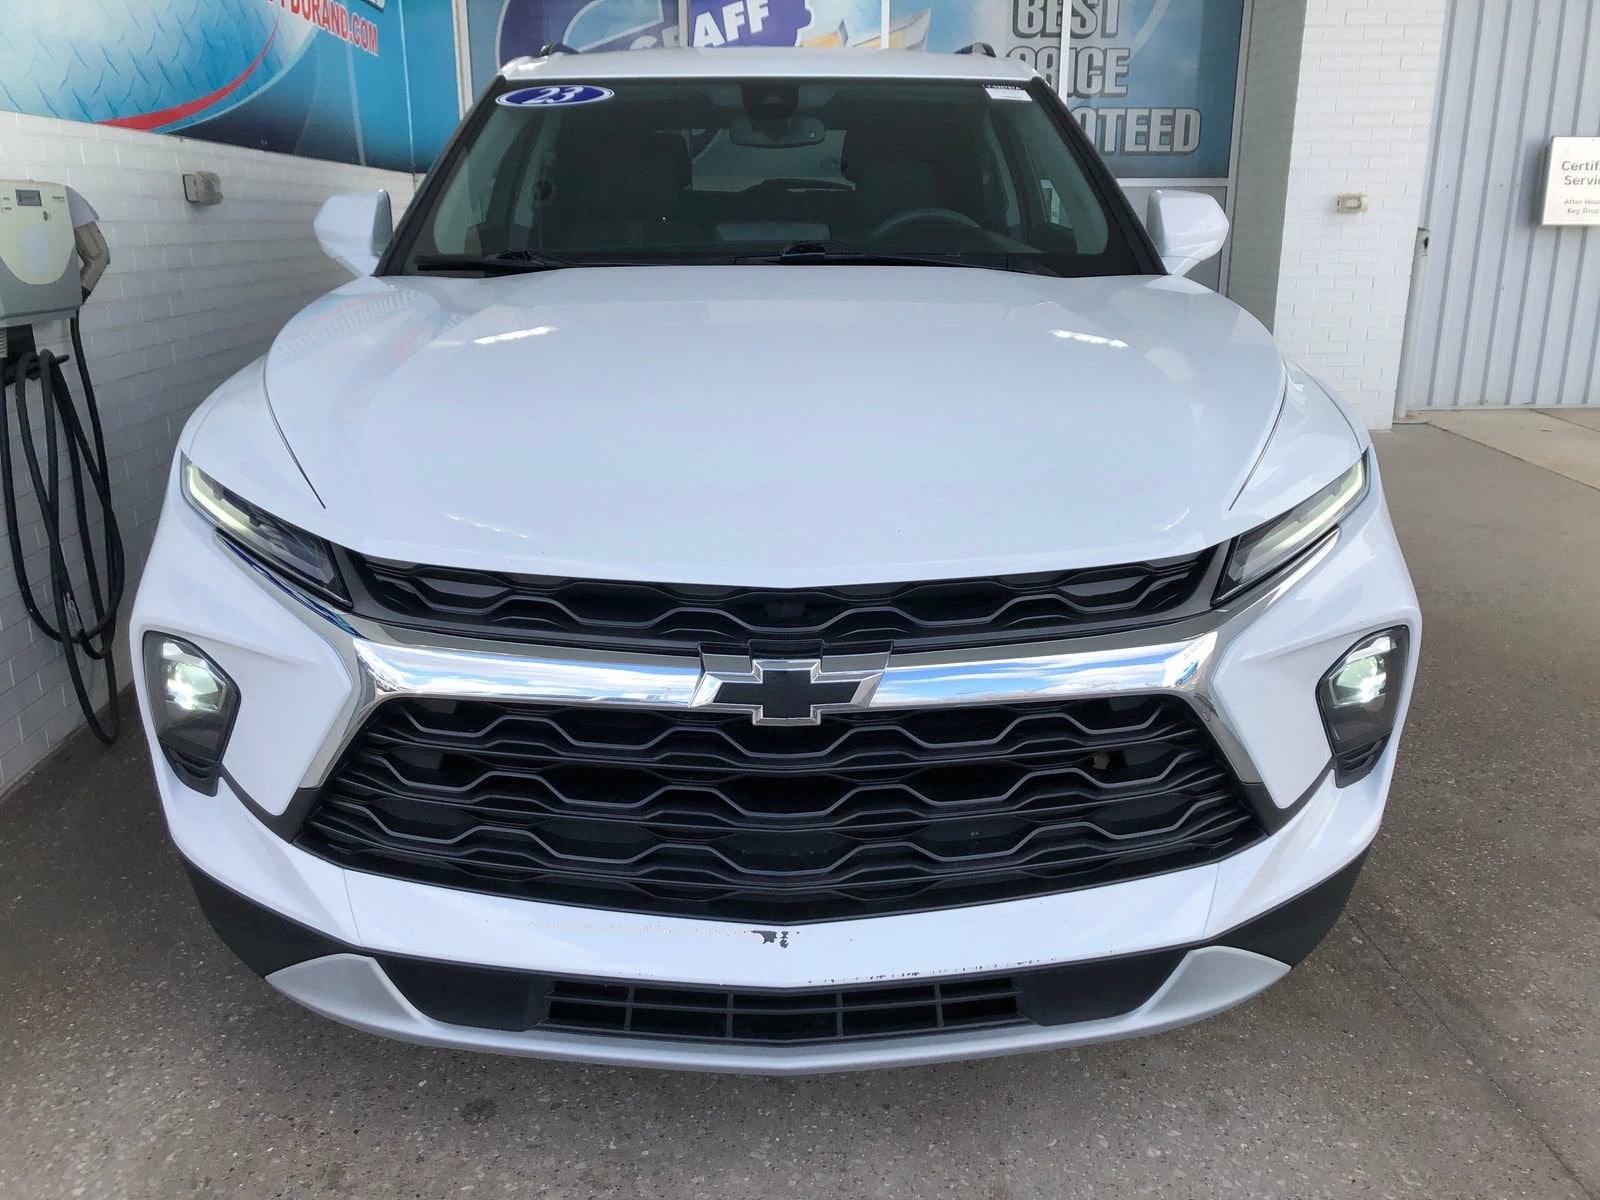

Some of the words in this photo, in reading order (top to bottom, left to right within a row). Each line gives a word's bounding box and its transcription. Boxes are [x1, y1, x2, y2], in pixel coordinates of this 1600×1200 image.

[1012, 0, 1119, 38] BEST
[520, 86, 584, 104] 23
[1561, 160, 1600, 171] Certif
[1567, 207, 1581, 215] Key
